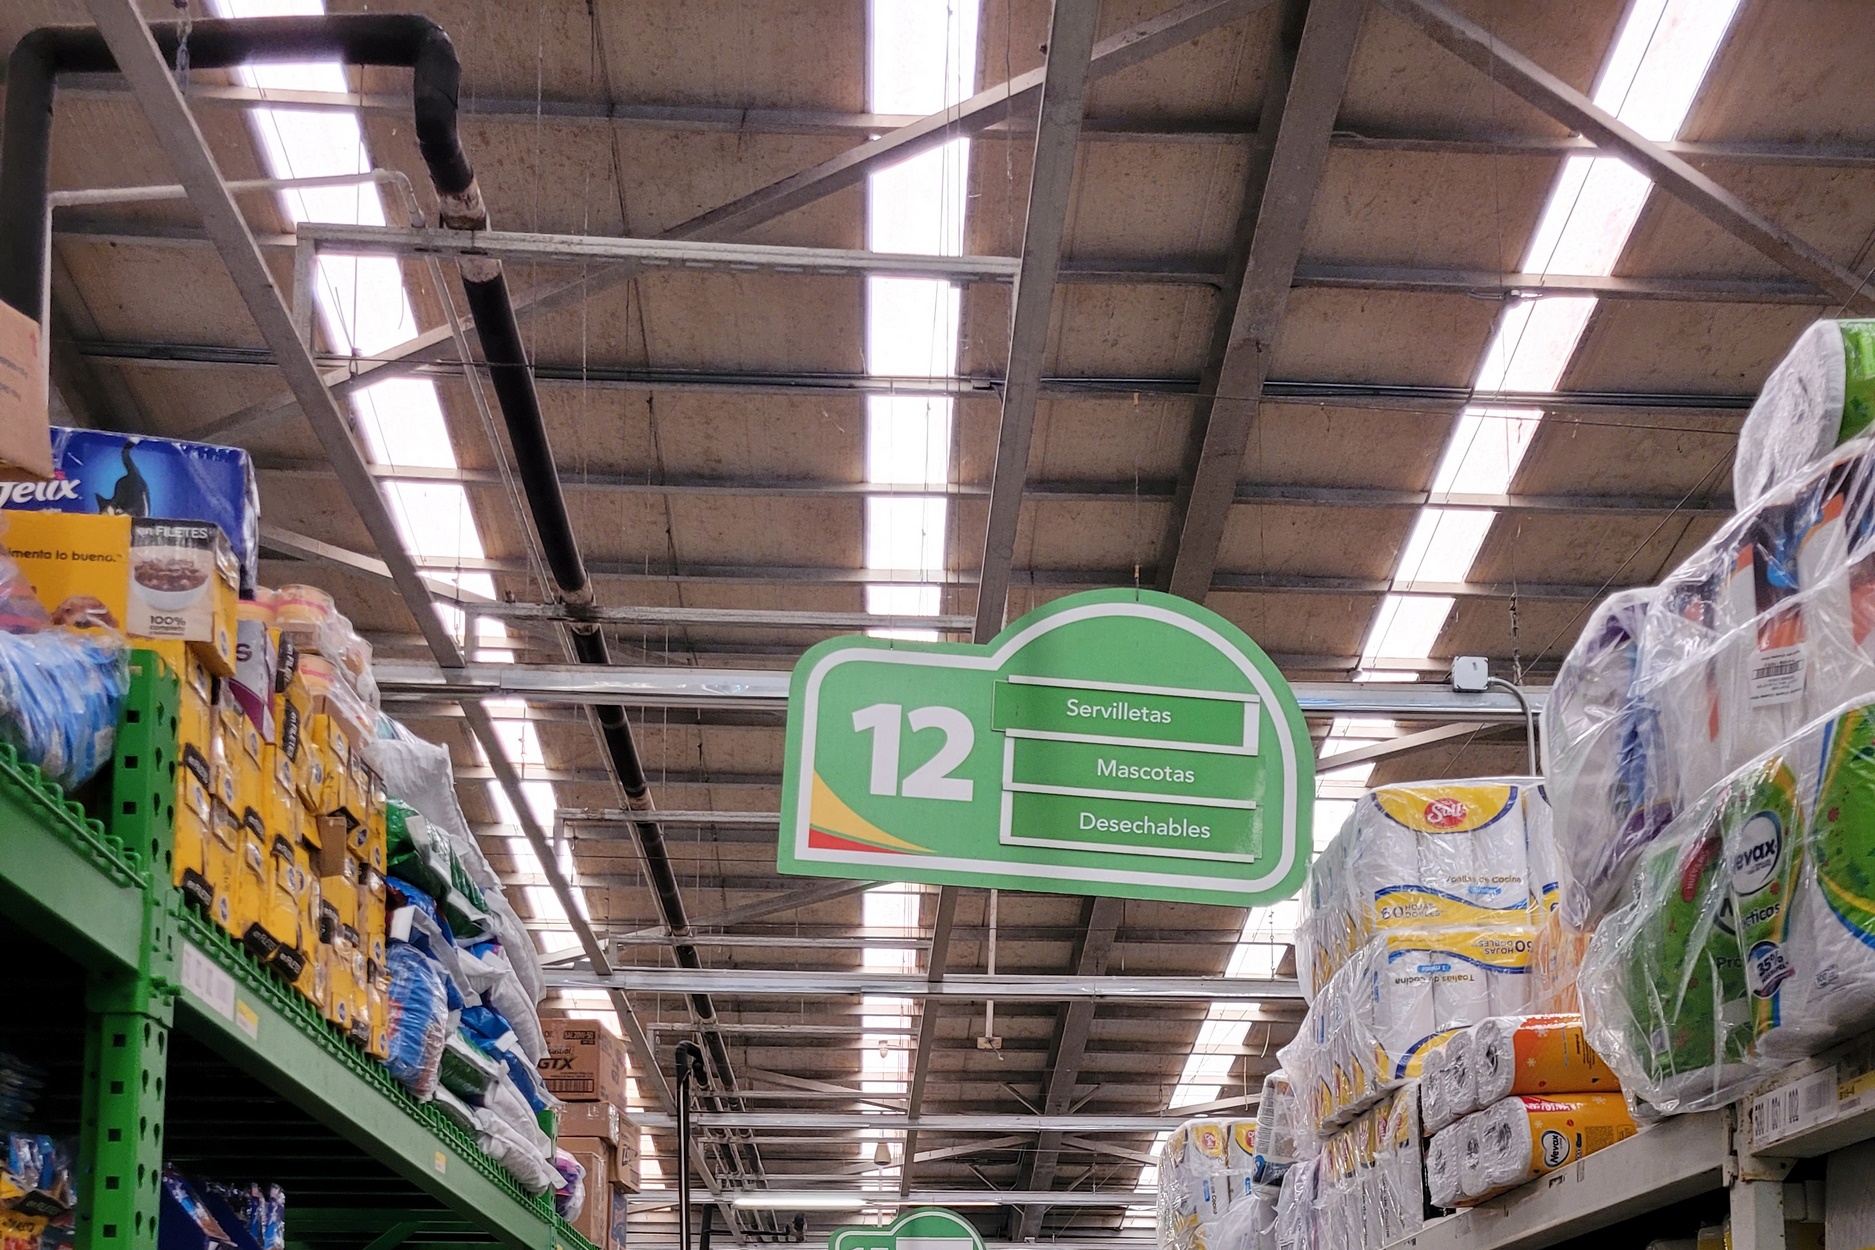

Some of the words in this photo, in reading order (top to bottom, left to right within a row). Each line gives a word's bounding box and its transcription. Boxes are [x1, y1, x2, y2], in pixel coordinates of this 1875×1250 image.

[155, 527, 208, 540] FILETES
[8, 550, 51, 560] imenta
[56, 550, 67, 560] lo
[72, 552, 117, 562] bueno.
[150, 615, 186, 625] 100%
[1066, 698, 1172, 725] Servilletas
[852, 703, 975, 802] 12
[1096, 758, 1195, 784] Mascotas
[1079, 811, 1211, 840] Desechables
[1492, 876, 1522, 884] Cocina
[1485, 947, 1514, 955] HOJAS
[1757, 952, 1784, 977] 35%
[537, 1056, 578, 1070] GTX
[1548, 1132, 1560, 1167] Nevax
